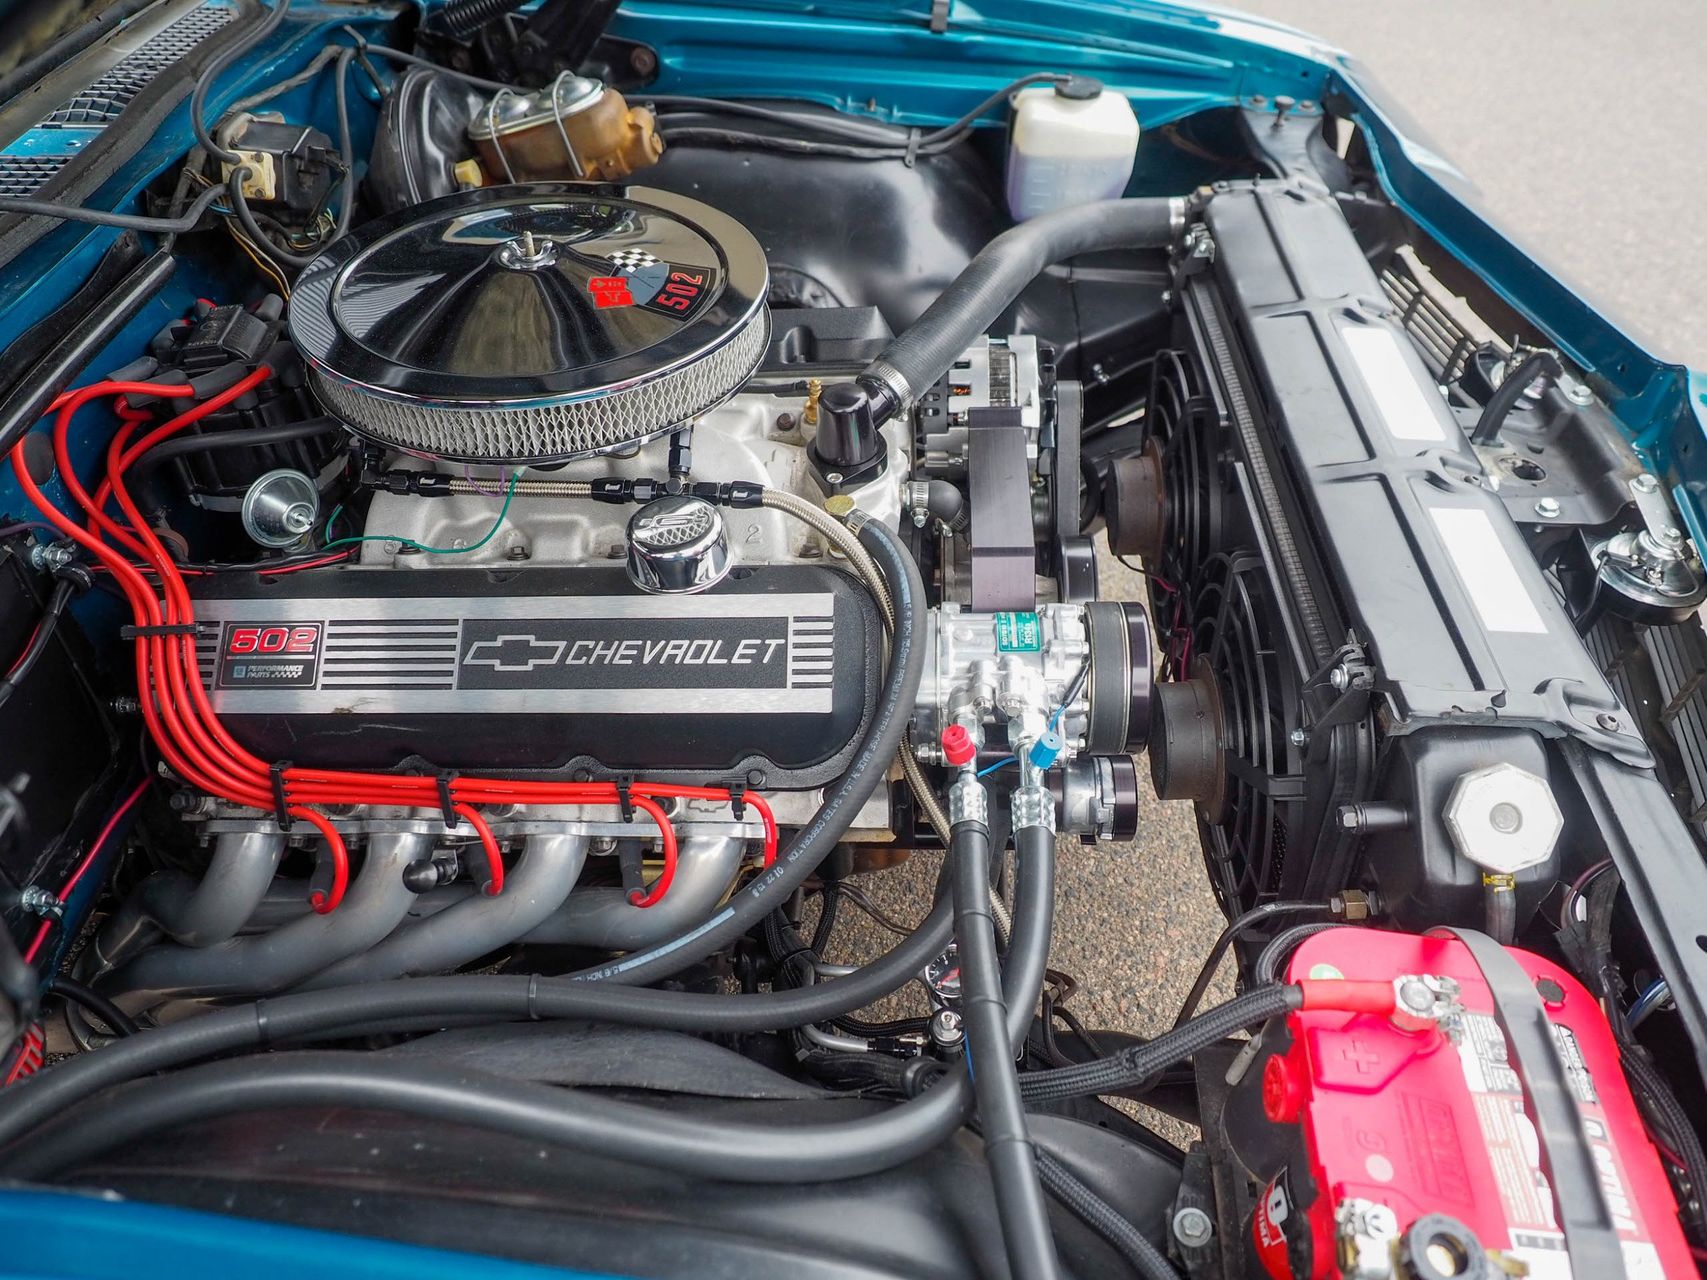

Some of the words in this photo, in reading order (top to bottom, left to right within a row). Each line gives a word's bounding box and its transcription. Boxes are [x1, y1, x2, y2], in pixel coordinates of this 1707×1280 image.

[655, 272, 703, 311] 502
[229, 627, 317, 653] 502
[564, 638, 786, 665] CHEVROLET
[247, 664, 305, 672] PERFORMANCE
[857, 751, 872, 772] MADE
[823, 797, 842, 821] GATES
[787, 820, 826, 863] CORPORATION
